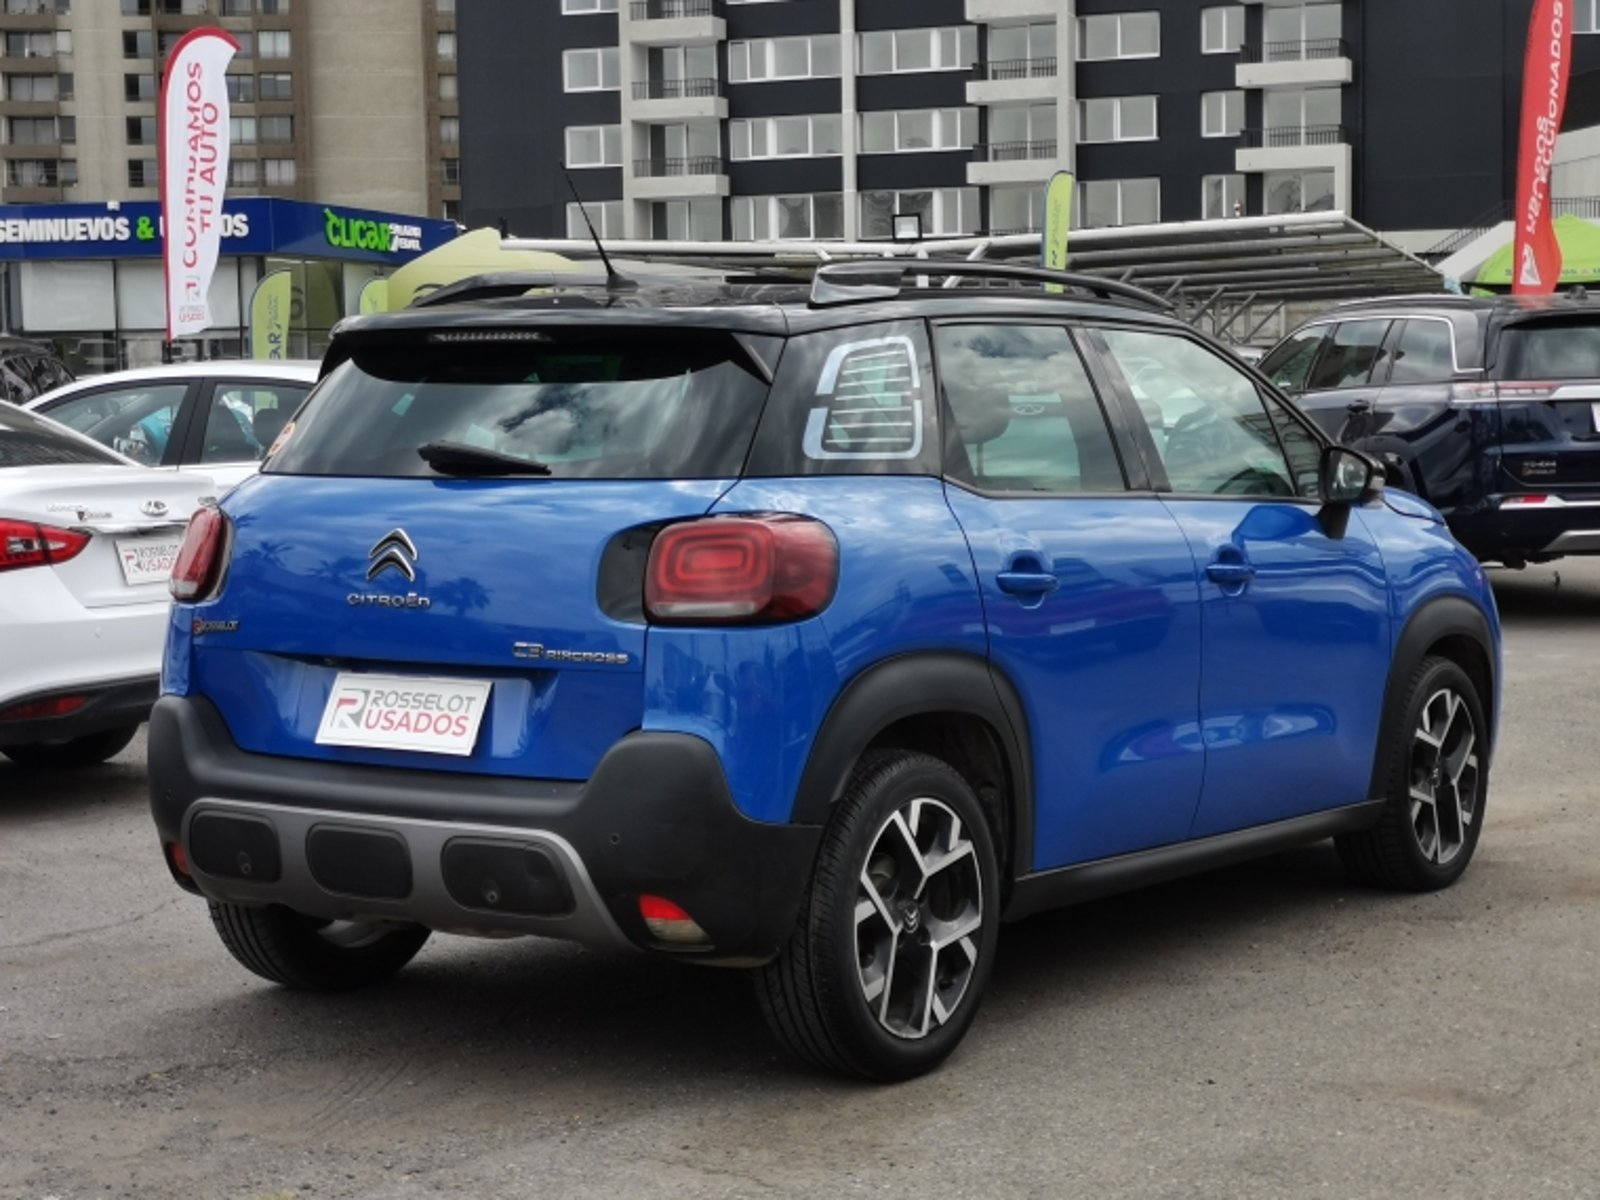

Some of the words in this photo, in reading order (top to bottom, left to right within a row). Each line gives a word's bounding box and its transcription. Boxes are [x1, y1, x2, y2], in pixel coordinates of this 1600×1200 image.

[199, 102, 219, 186] AUTO
[136, 216, 155, 240] &
[513, 641, 544, 658] C3
[545, 649, 629, 664] AIRCROSS
[368, 689, 476, 714] ROSSELOT
[364, 708, 469, 736] USADOS
